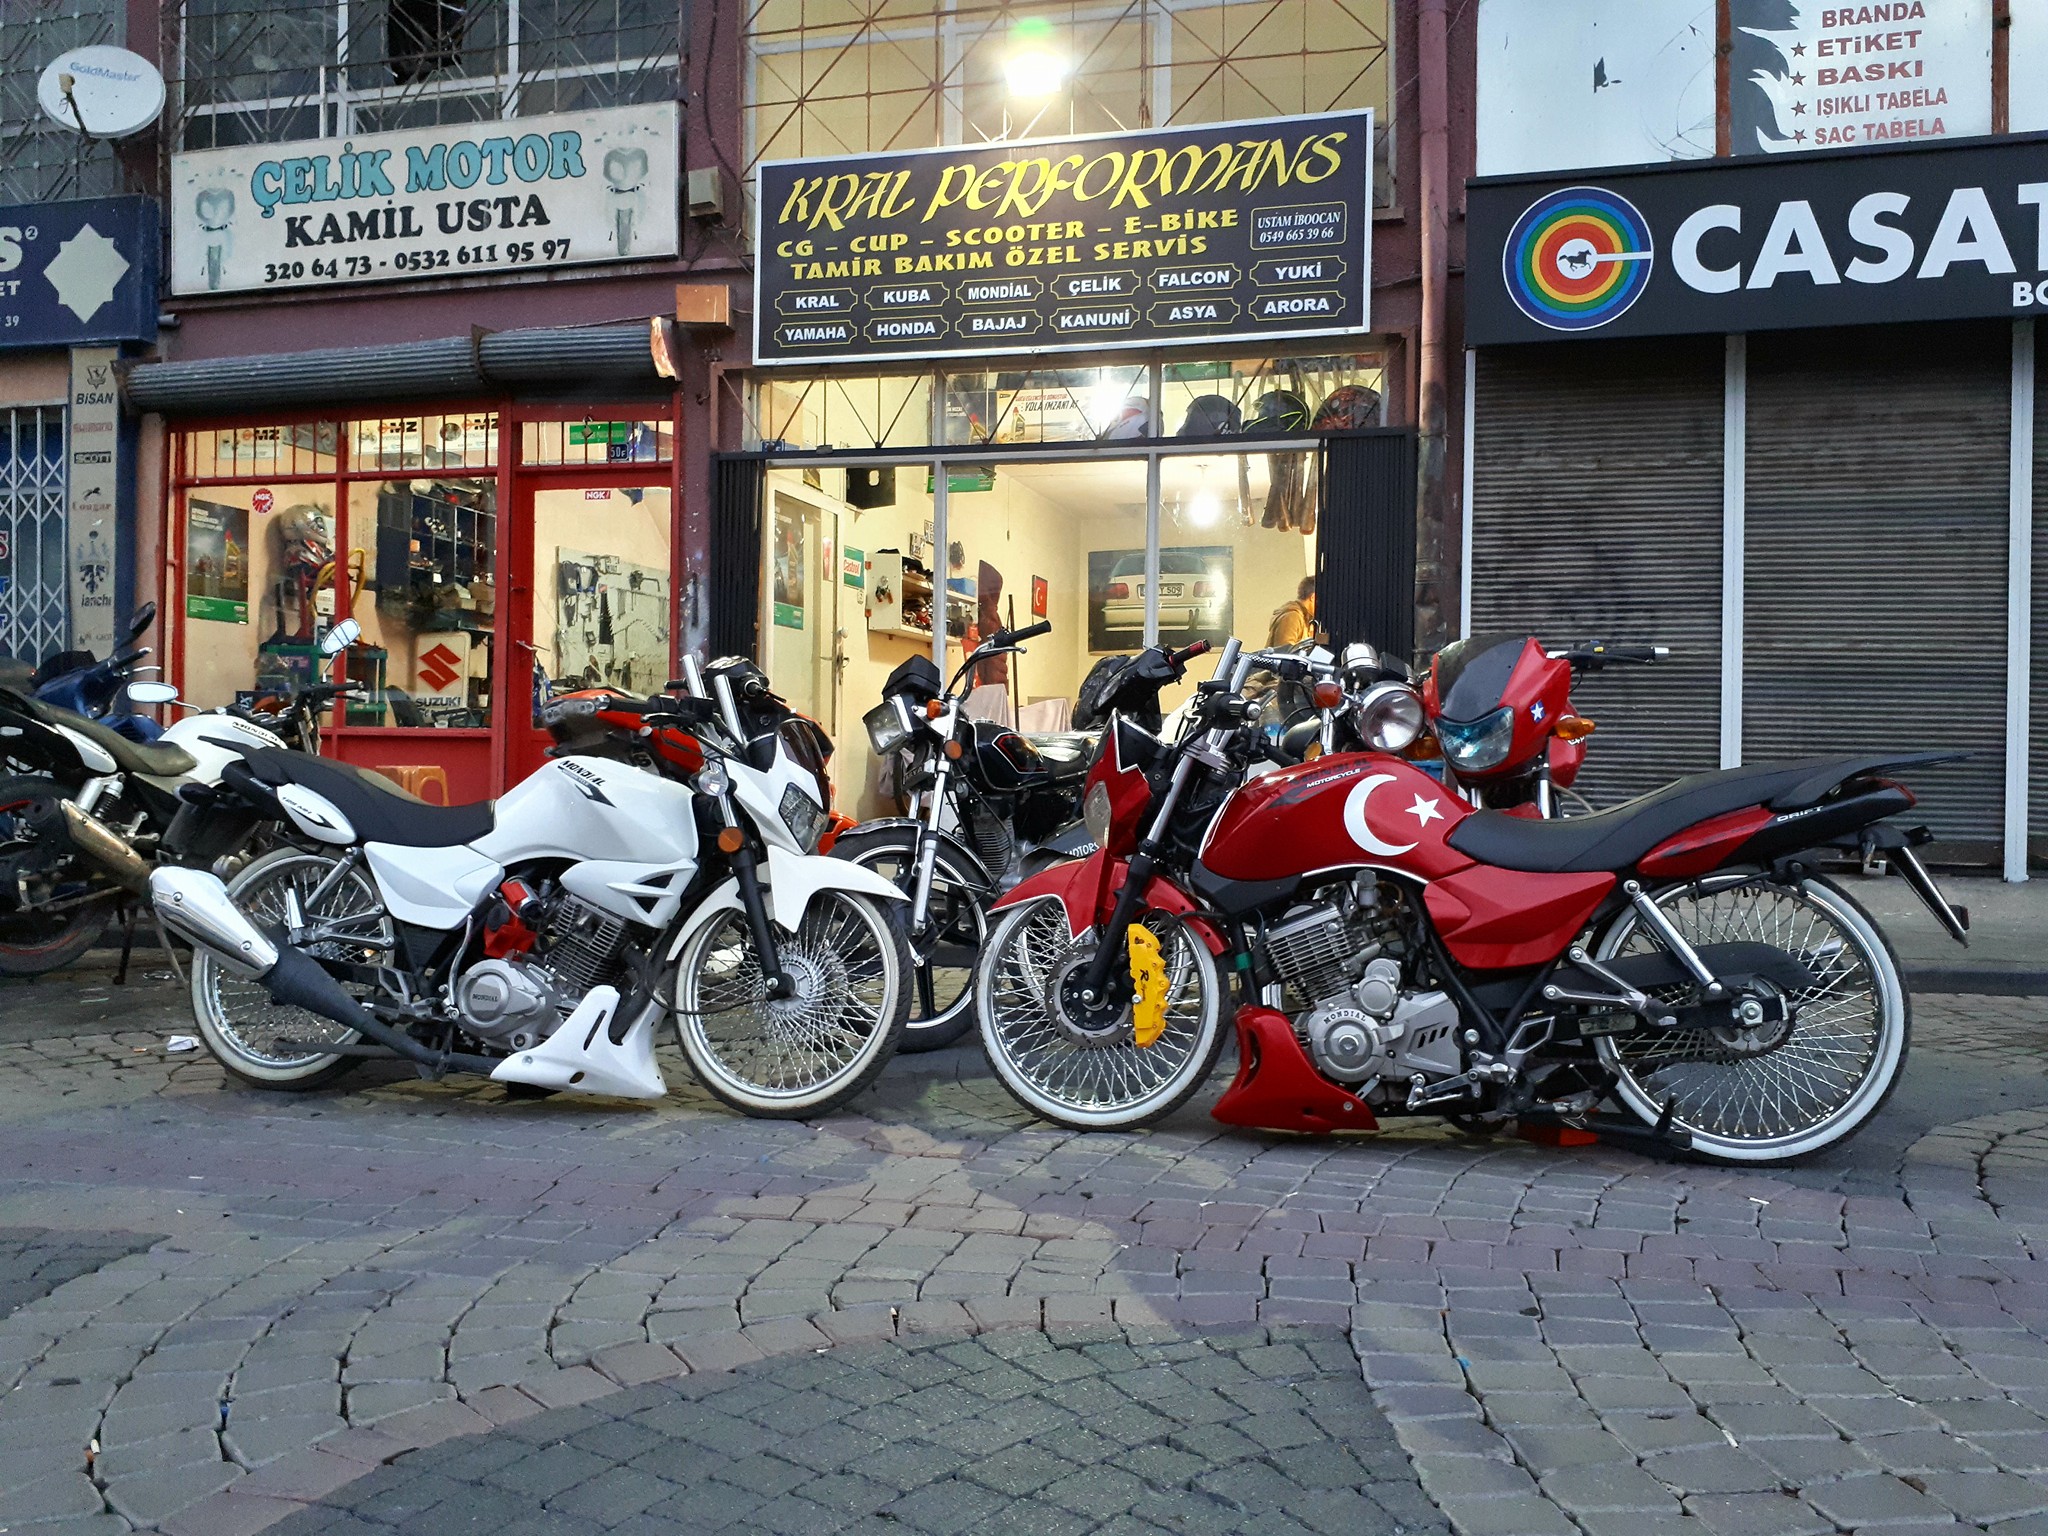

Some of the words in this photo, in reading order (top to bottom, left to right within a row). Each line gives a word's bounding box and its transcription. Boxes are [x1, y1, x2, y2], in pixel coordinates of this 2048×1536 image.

[1822, 1, 1926, 28] BRANDA
[1817, 60, 1923, 86] BASKI
[1876, 87, 1948, 111] TABELA
[1814, 125, 1856, 145] SAC
[1863, 117, 1946, 141] TABELA
[251, 142, 394, 218] ÇELİK
[405, 130, 586, 193] MOTOR
[778, 169, 916, 232] KRAL
[920, 132, 1348, 224] PERFORMANS
[285, 199, 423, 248] KAMİL
[436, 194, 550, 234] USTA
[1257, 214, 1293, 229] USTAM
[776, 239, 814, 258] CG
[850, 233, 909, 253] CUP
[946, 220, 1086, 247] SCOOTER
[1259, 230, 1284, 243] 0549
[1286, 229, 1305, 241] 665
[1306, 228, 1319, 240] 39
[1321, 226, 1334, 239] 66
[264, 262, 304, 282] 320
[311, 259, 338, 278] 64
[345, 256, 372, 275] 73
[394, 249, 450, 270] 0532
[457, 244, 498, 265] 611
[506, 242, 534, 263] 95
[542, 238, 571, 260] 97
[790, 257, 883, 280] TAMİR
[895, 251, 994, 274] BAKIM
[1005, 244, 1082, 267] ÖZEL
[1094, 234, 1208, 261] SERVİS
[1158, 270, 1231, 288] FALCON
[1275, 261, 1322, 280] YUKİ
[968, 282, 1032, 300] MONDİAL
[1068, 275, 1122, 296] ÇELİK
[795, 295, 840, 310] KRAL
[883, 289, 931, 303] KUBA
[1168, 305, 1217, 321] ASYA
[1264, 298, 1330, 314] ARORA
[972, 316, 1027, 332] BAJAJ
[1060, 308, 1130, 328] KANUNİ
[784, 326, 847, 341] YAMAHA
[876, 321, 936, 337] HONDA
[416, 696, 461, 707] SUZUKI
[561, 760, 606, 786] MONDIAL
[1306, 768, 1361, 788] MOTORCYCLE
[1776, 805, 1824, 822] DRIFT
[1323, 1010, 1366, 1024] MONDIAL
